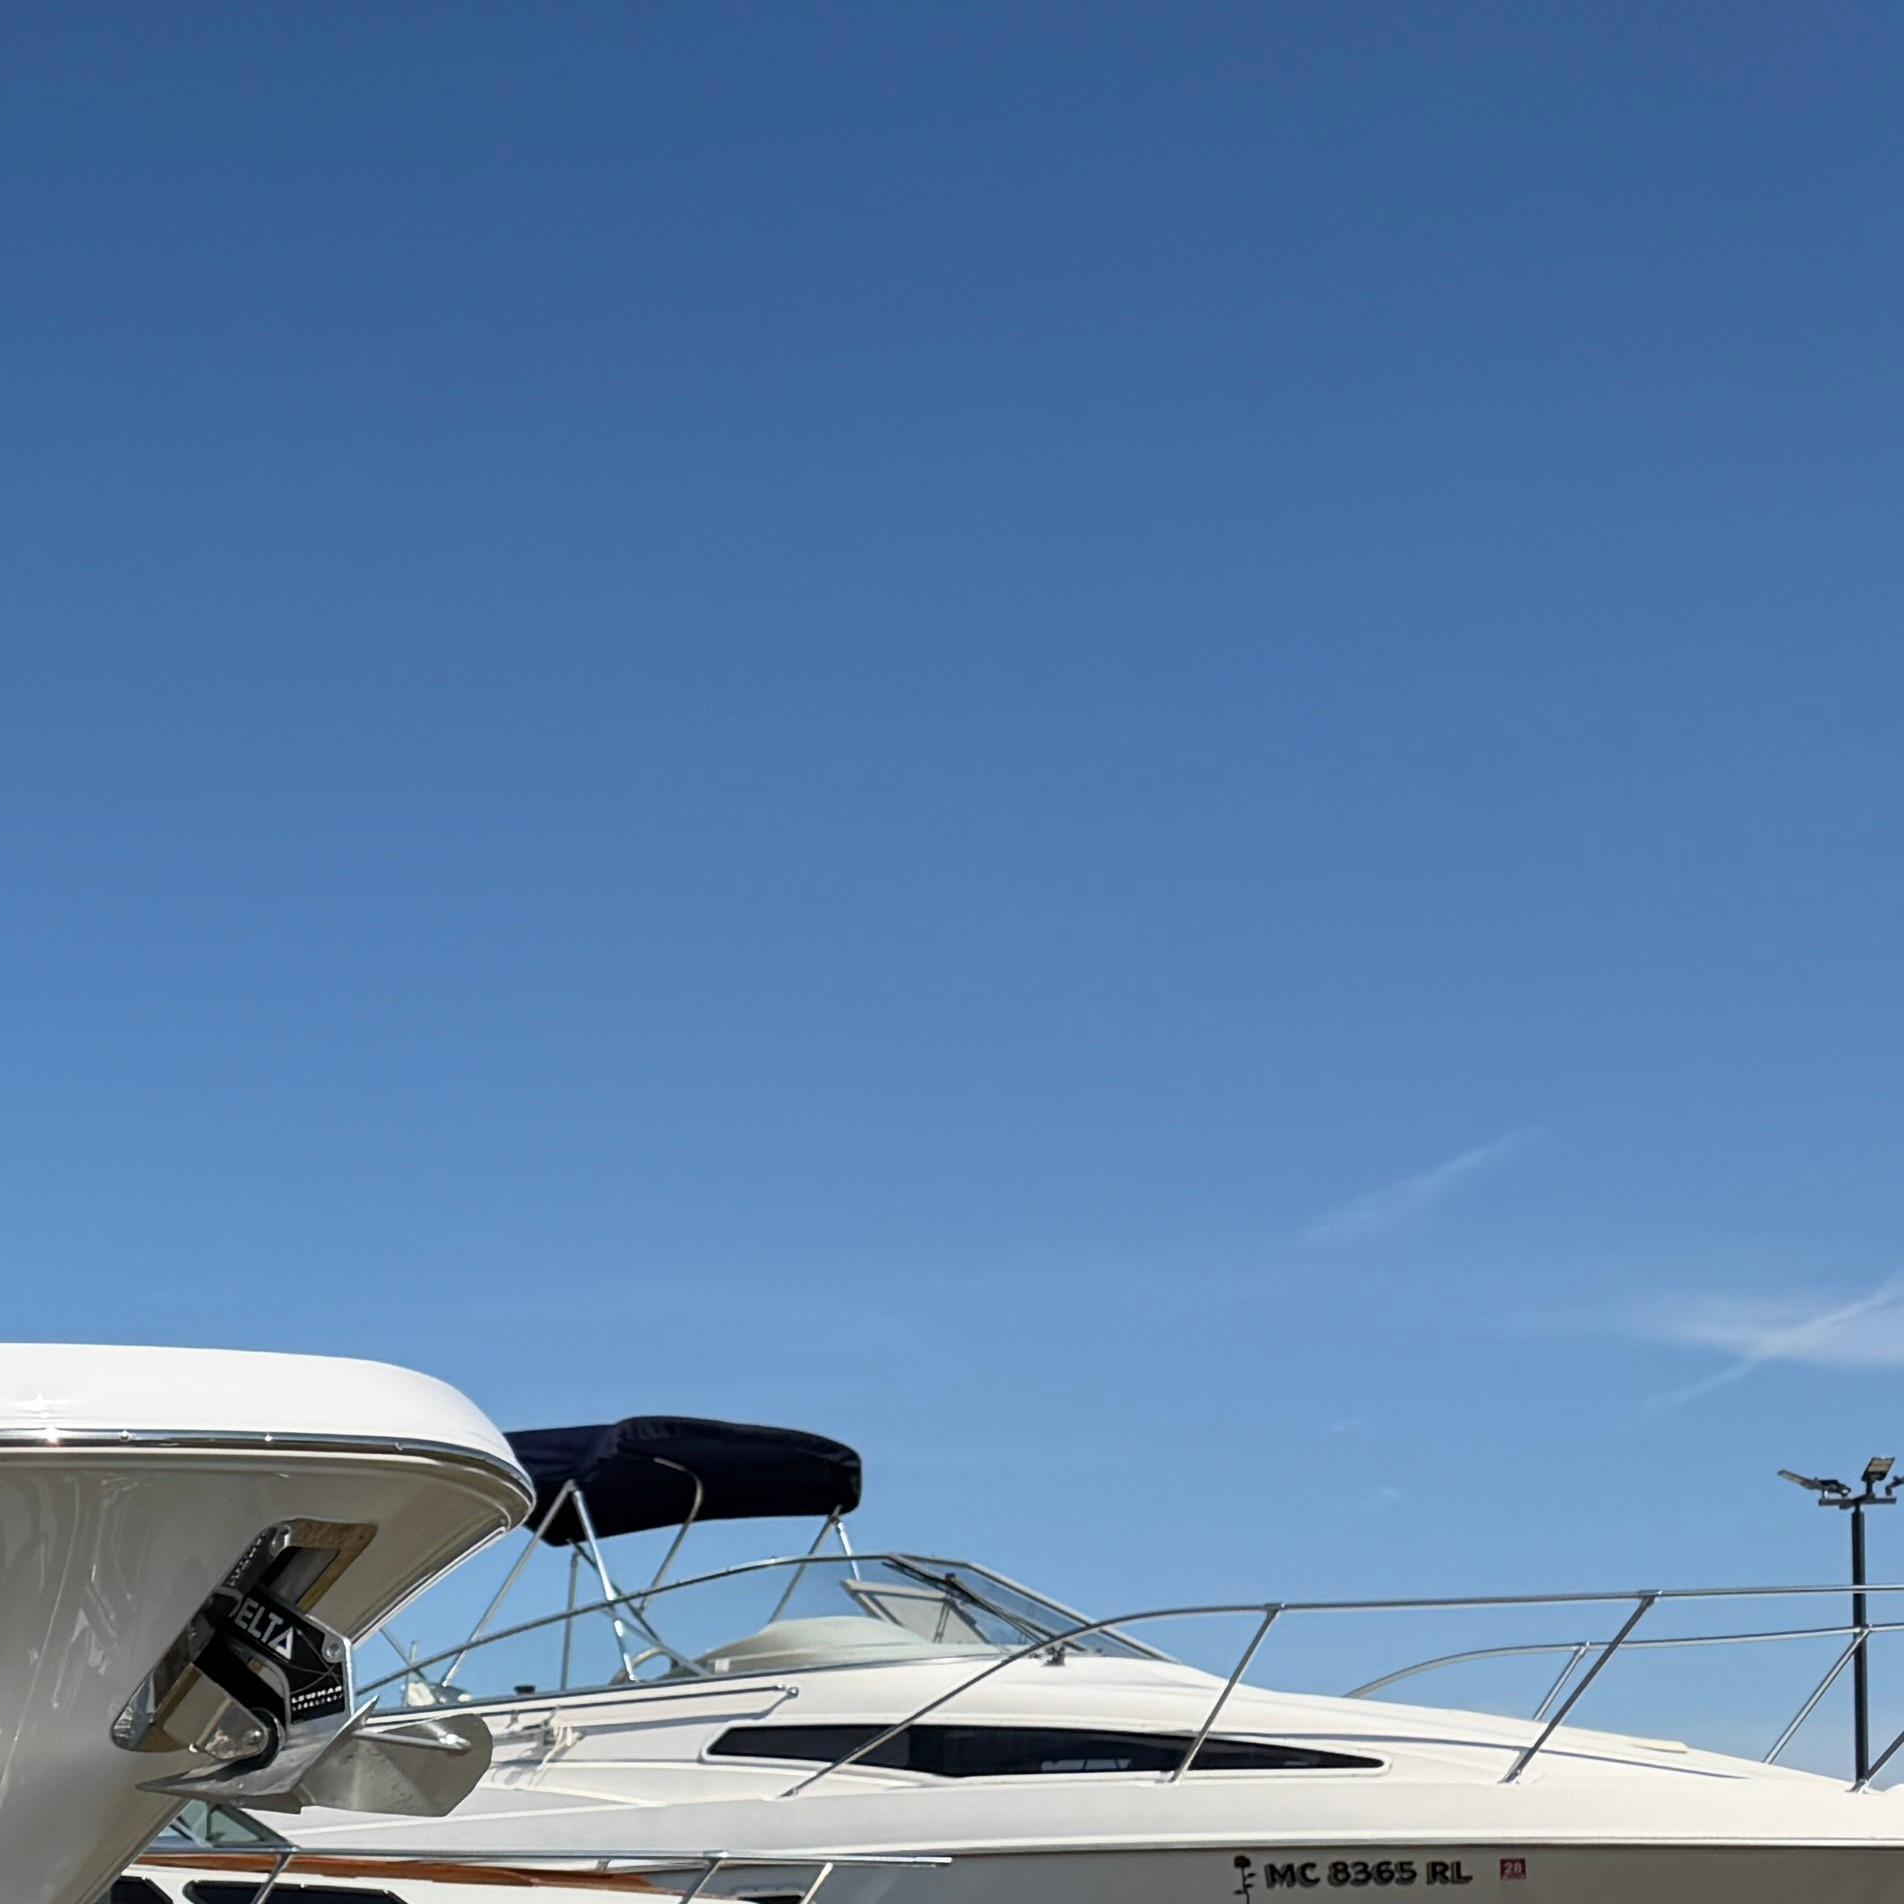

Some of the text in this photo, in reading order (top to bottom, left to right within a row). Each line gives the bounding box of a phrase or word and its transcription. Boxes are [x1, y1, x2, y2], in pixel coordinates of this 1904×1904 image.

[1264, 1860, 1474, 1889] MC 8365 RL
